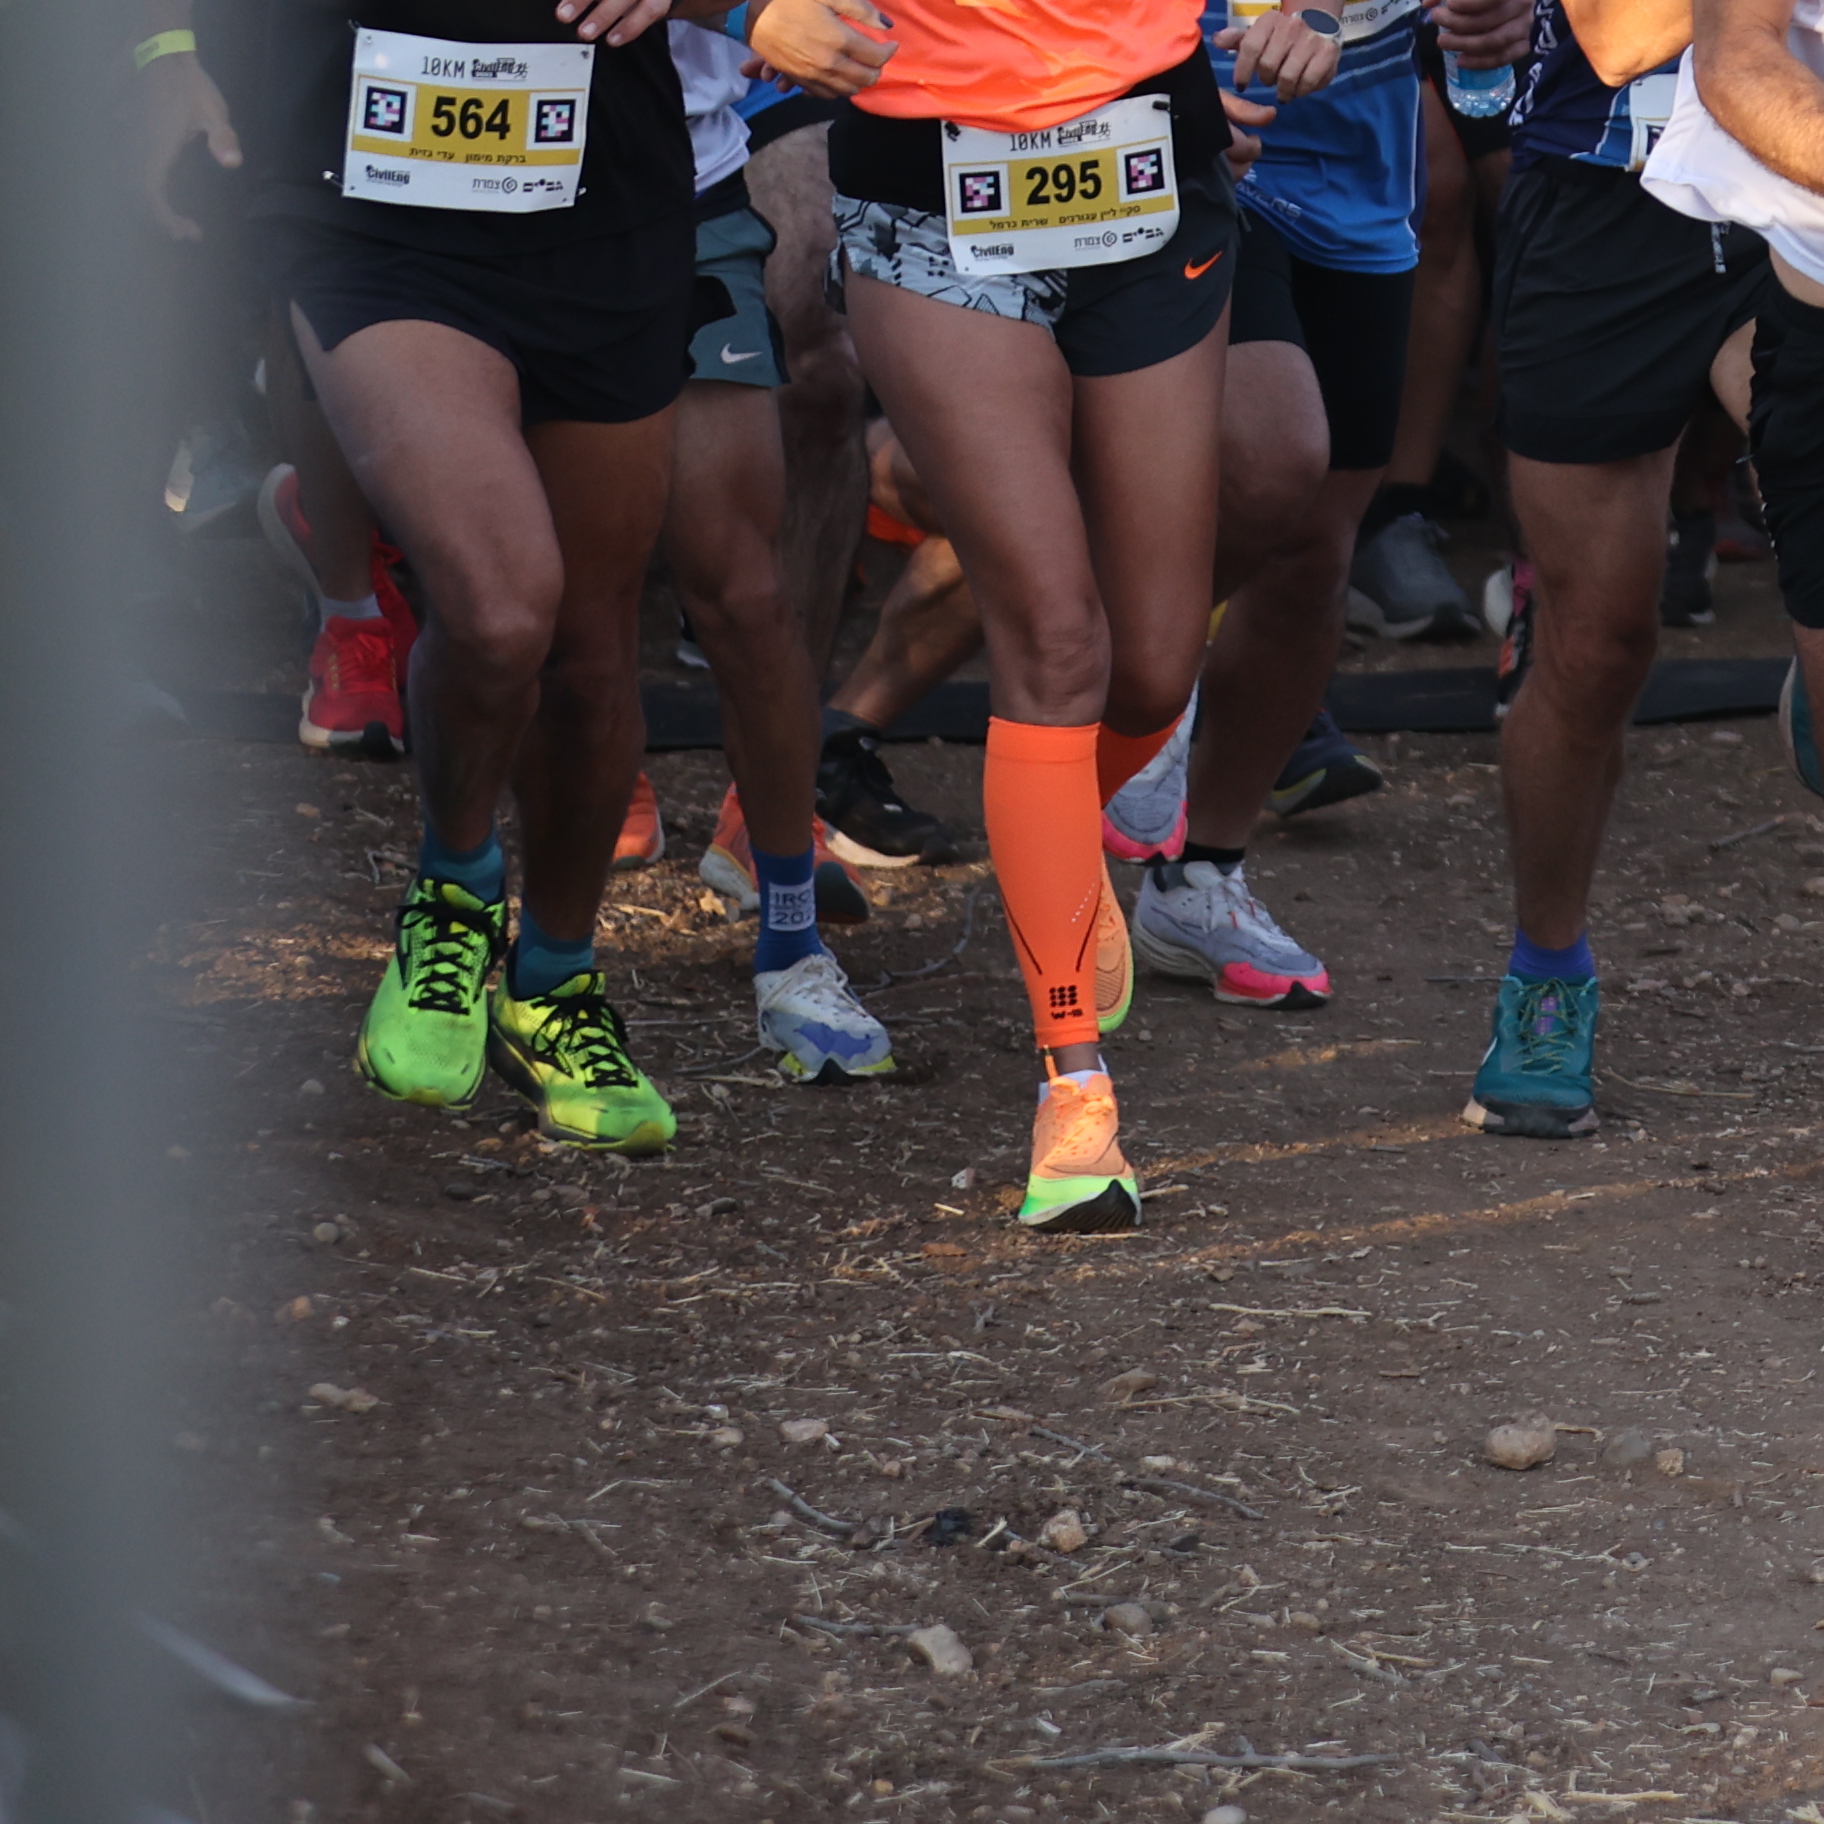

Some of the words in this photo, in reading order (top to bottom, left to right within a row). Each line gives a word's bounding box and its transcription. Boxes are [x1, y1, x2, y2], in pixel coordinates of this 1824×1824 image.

[421, 55, 466, 79] 10KM
[431, 95, 511, 140] 564
[1009, 132, 1052, 152] 10KM
[366, 165, 411, 185] CivilEng
[1026, 160, 1103, 207] 295
[971, 244, 1014, 258] CivilEng
